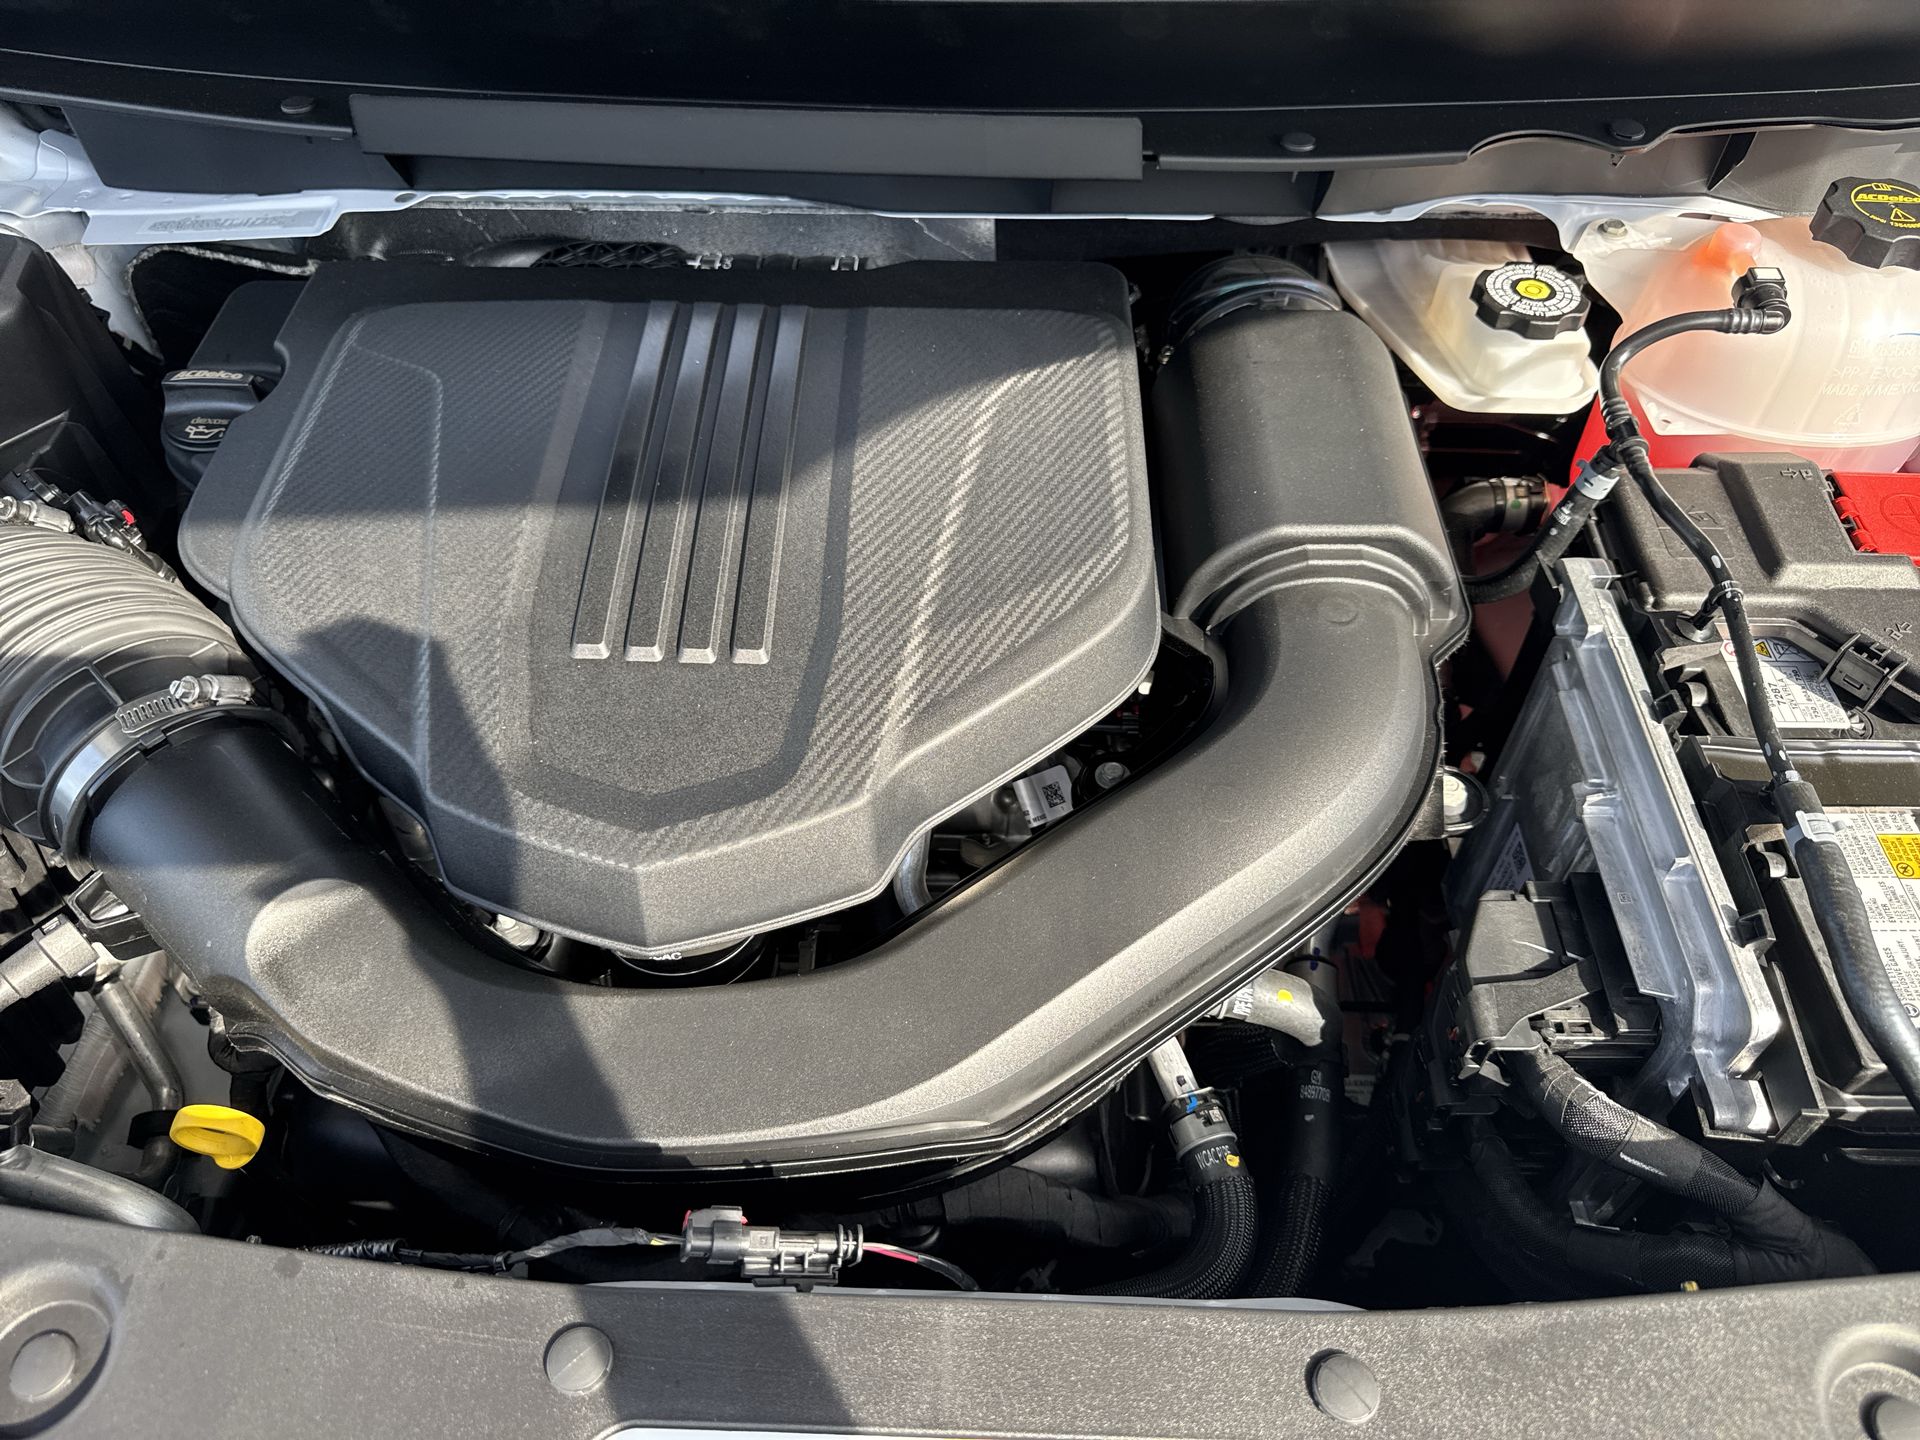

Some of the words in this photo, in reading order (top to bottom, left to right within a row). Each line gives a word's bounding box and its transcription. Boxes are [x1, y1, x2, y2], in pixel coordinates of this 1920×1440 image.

[171, 370, 243, 380] ACDelco
[1791, 670, 1803, 681] 730
[1777, 678, 1792, 696] VRLA
[1767, 682, 1787, 706] 7287
[1787, 698, 1800, 709] 12V
[1810, 707, 1821, 718] 730
[1869, 814, 1880, 823] NOT
[1879, 817, 1892, 829] OPEN
[1888, 814, 1899, 823] PAS
[1887, 852, 1898, 861] KEEP
[1873, 862, 1886, 874] PEUT
[1893, 911, 1903, 919] LES
[1900, 911, 1910, 919] LES
[1882, 948, 1899, 966] GASES
[1892, 968, 1916, 1001] EXPLOSIVE
[1903, 971, 1918, 988] CAUSE
